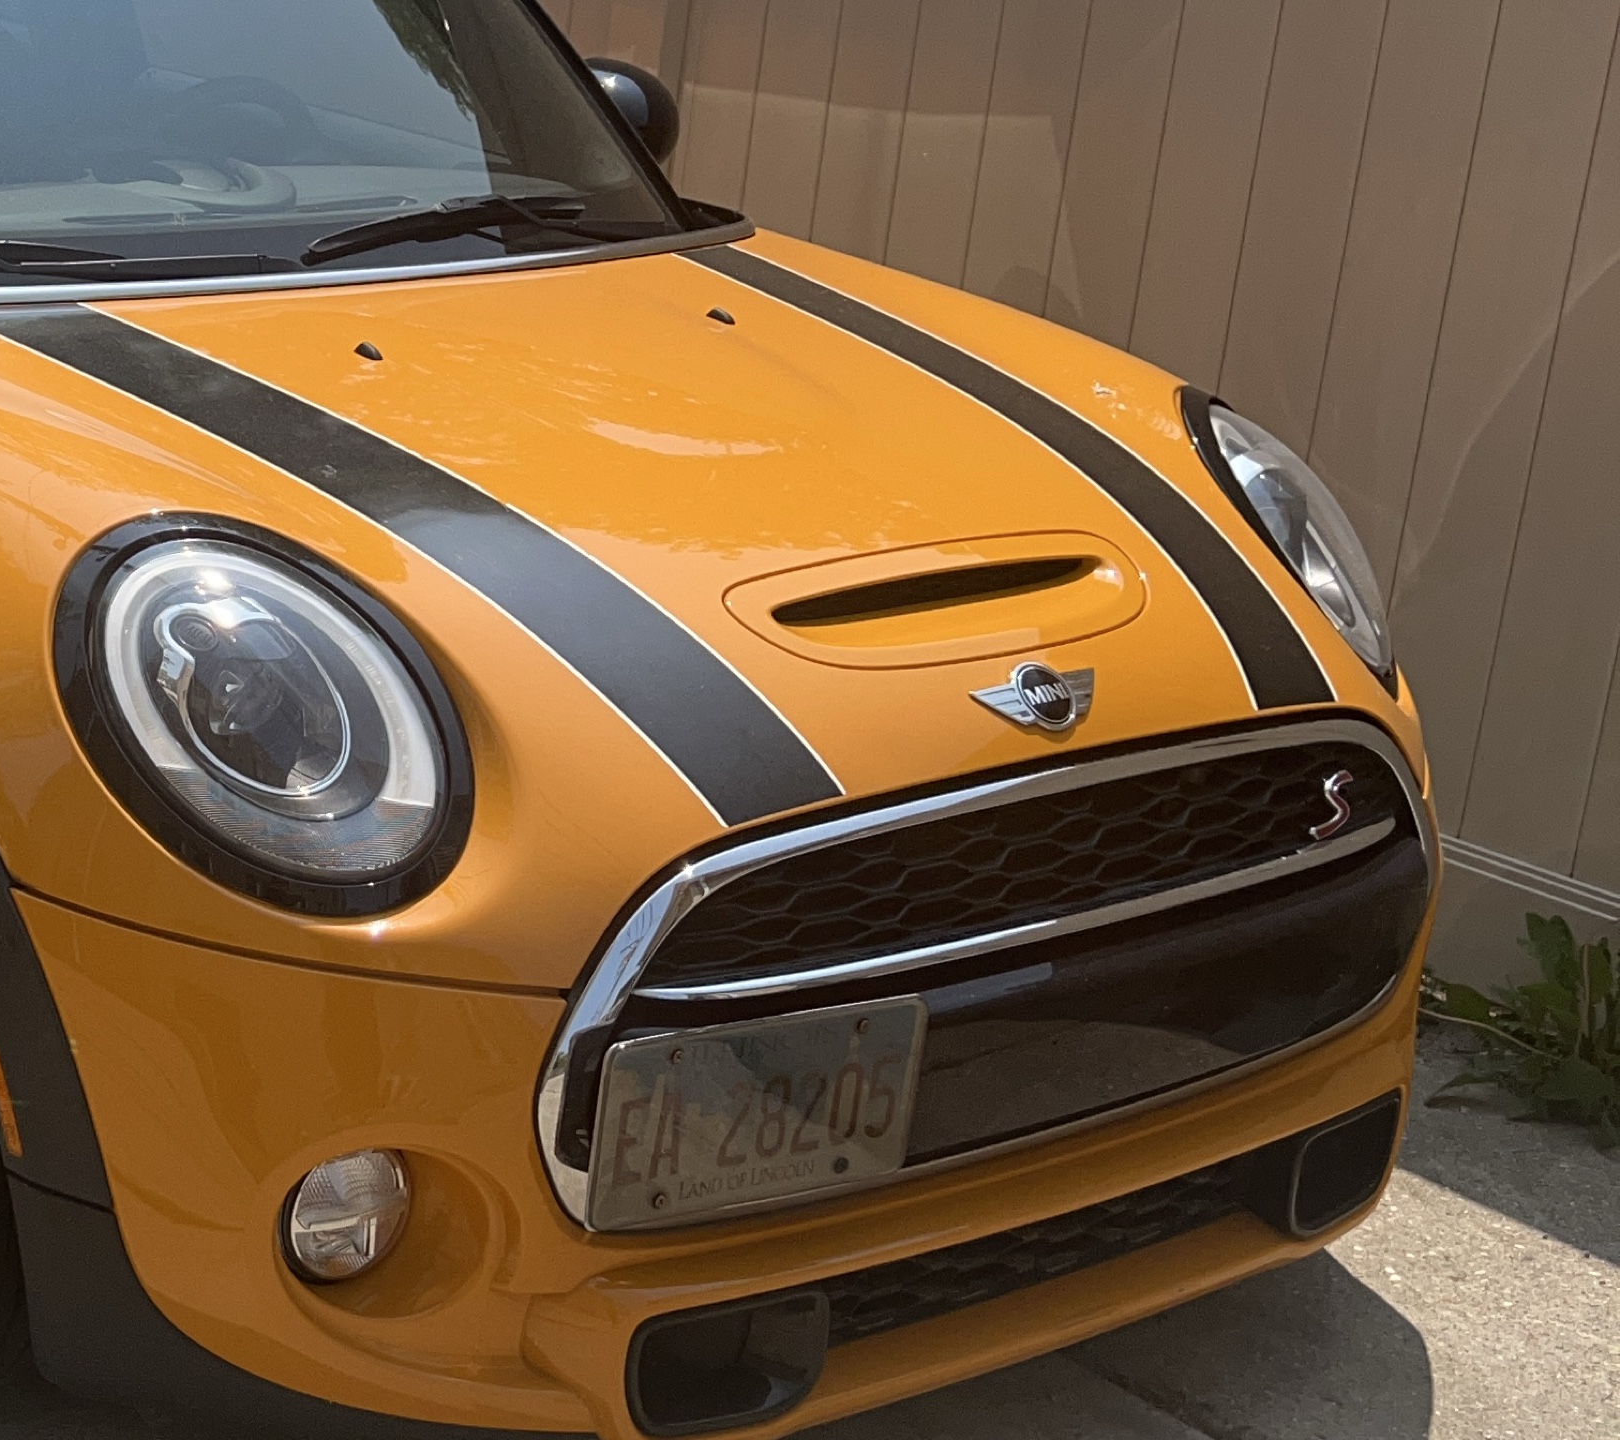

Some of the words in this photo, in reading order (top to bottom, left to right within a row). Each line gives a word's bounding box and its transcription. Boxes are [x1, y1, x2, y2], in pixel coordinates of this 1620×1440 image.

[1023, 682, 1070, 706] MINI
[1308, 769, 1354, 841] S
[611, 1091, 681, 1188] EA
[716, 1049, 902, 1168] 28205
[677, 1176, 723, 1201] LAND
[726, 1171, 748, 1192] OF
[750, 1160, 815, 1187] LINCOLN
